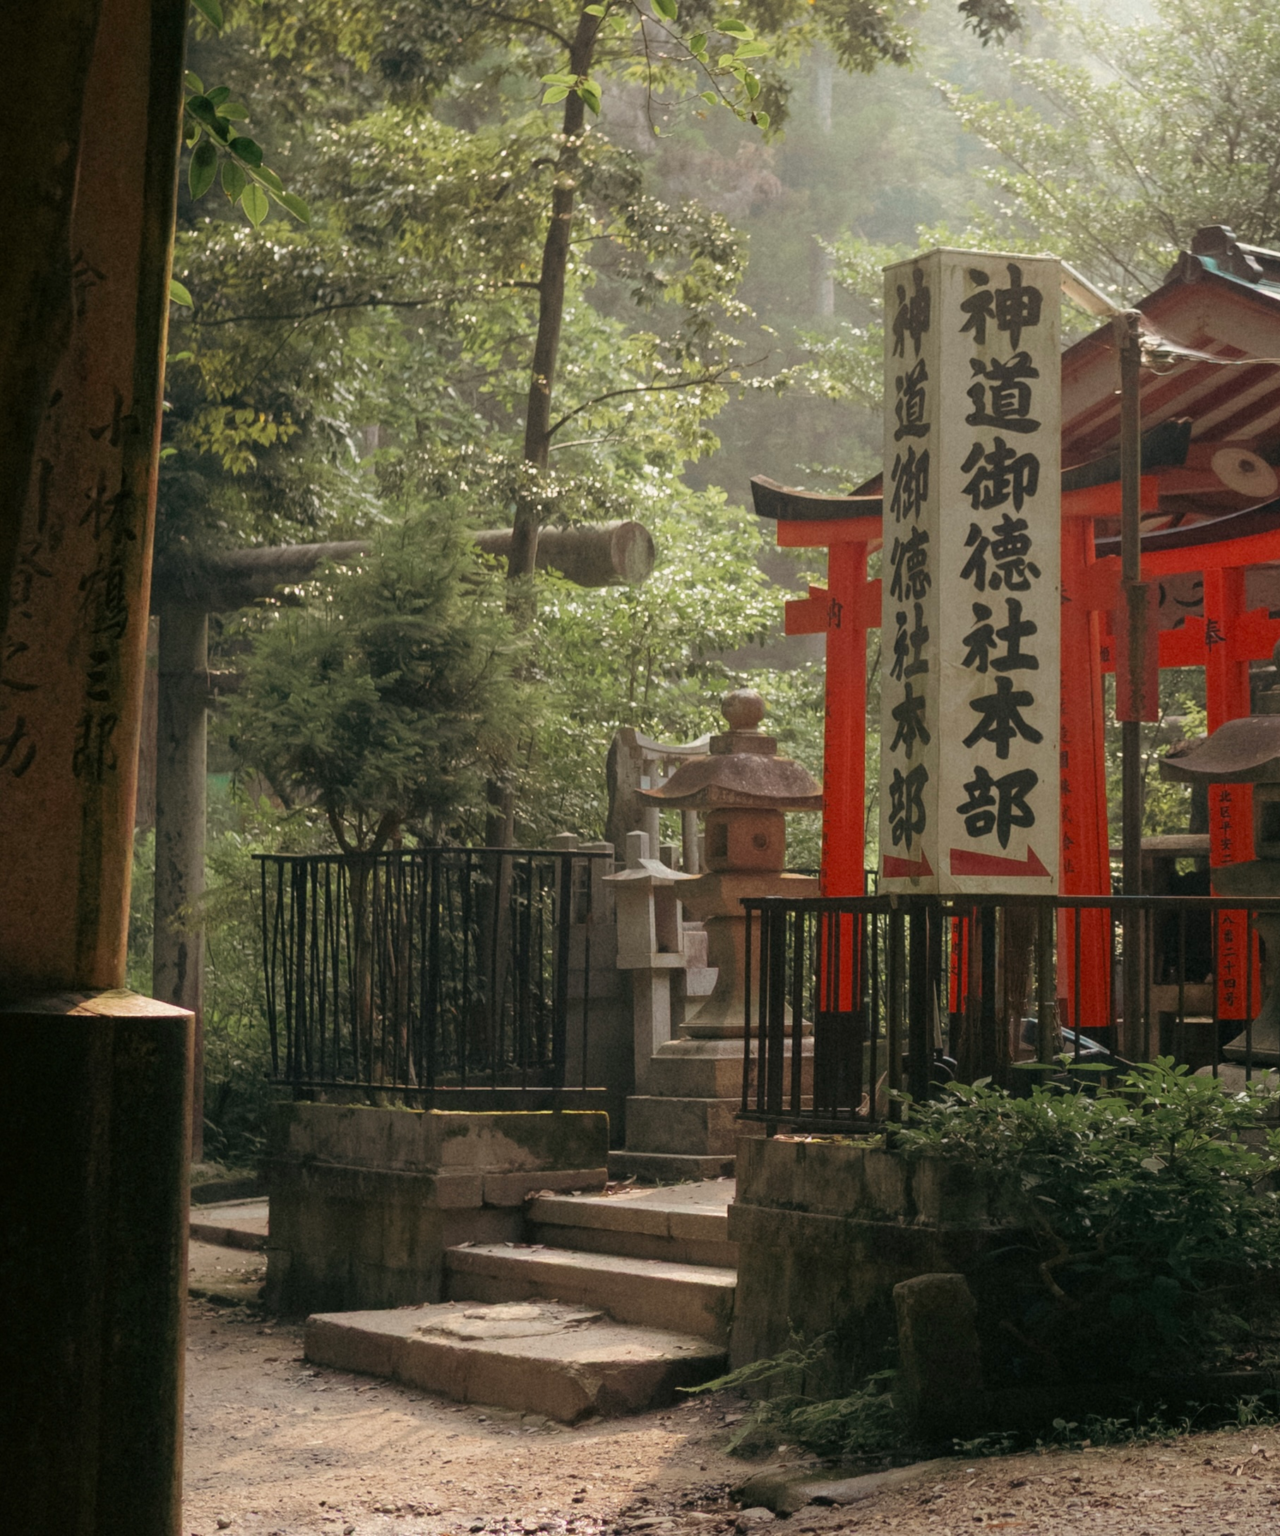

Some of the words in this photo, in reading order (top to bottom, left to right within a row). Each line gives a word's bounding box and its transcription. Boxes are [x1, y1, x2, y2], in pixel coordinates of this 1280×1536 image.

[891, 265, 932, 854] 神道御徳社本部
[957, 263, 1044, 850] 神道御徳社本部
